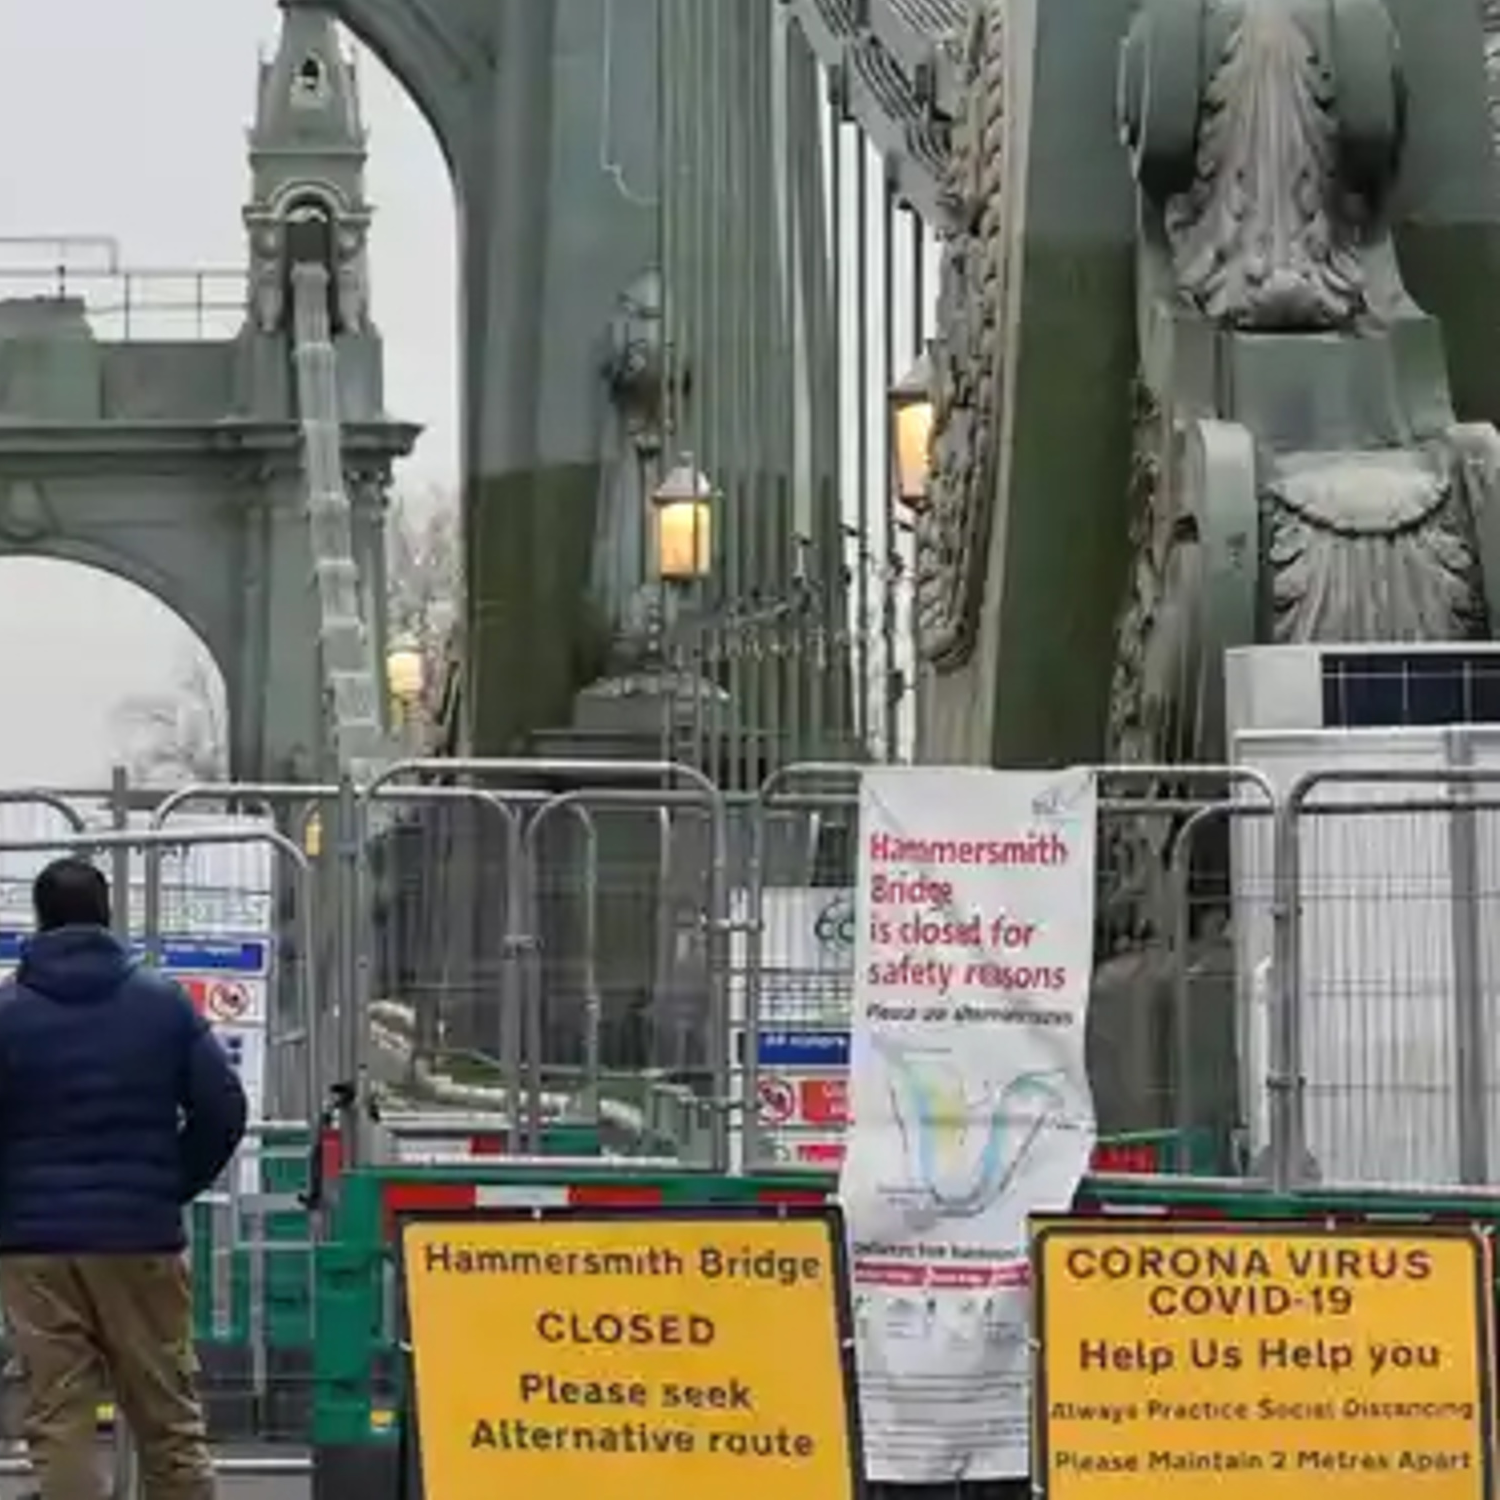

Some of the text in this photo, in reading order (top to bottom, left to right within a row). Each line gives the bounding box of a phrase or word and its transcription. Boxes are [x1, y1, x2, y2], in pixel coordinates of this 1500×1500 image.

[870, 833, 1068, 864] Hammersmith
[870, 872, 953, 911] Bridge
[870, 912, 891, 944] is
[899, 911, 981, 946] closed
[991, 914, 1036, 947] for
[867, 954, 951, 995] safety
[425, 1243, 684, 1278] Hammersmith
[698, 1247, 821, 1284] Bridge
[1065, 1247, 1272, 1280] CORONA
[1288, 1247, 1433, 1279] VIRUS
[1148, 1285, 1354, 1317] COVID-19
[537, 1312, 716, 1345] CLOSED
[1078, 1339, 1441, 1373] Help Us Help you
[520, 1373, 753, 1410] Please seek
[1050, 1399, 1475, 1424] Always Practice Social Distancing
[470, 1419, 815, 1458] Alternative route
[1054, 1450, 1473, 1473] Please Maintain 2 Metres Apart
